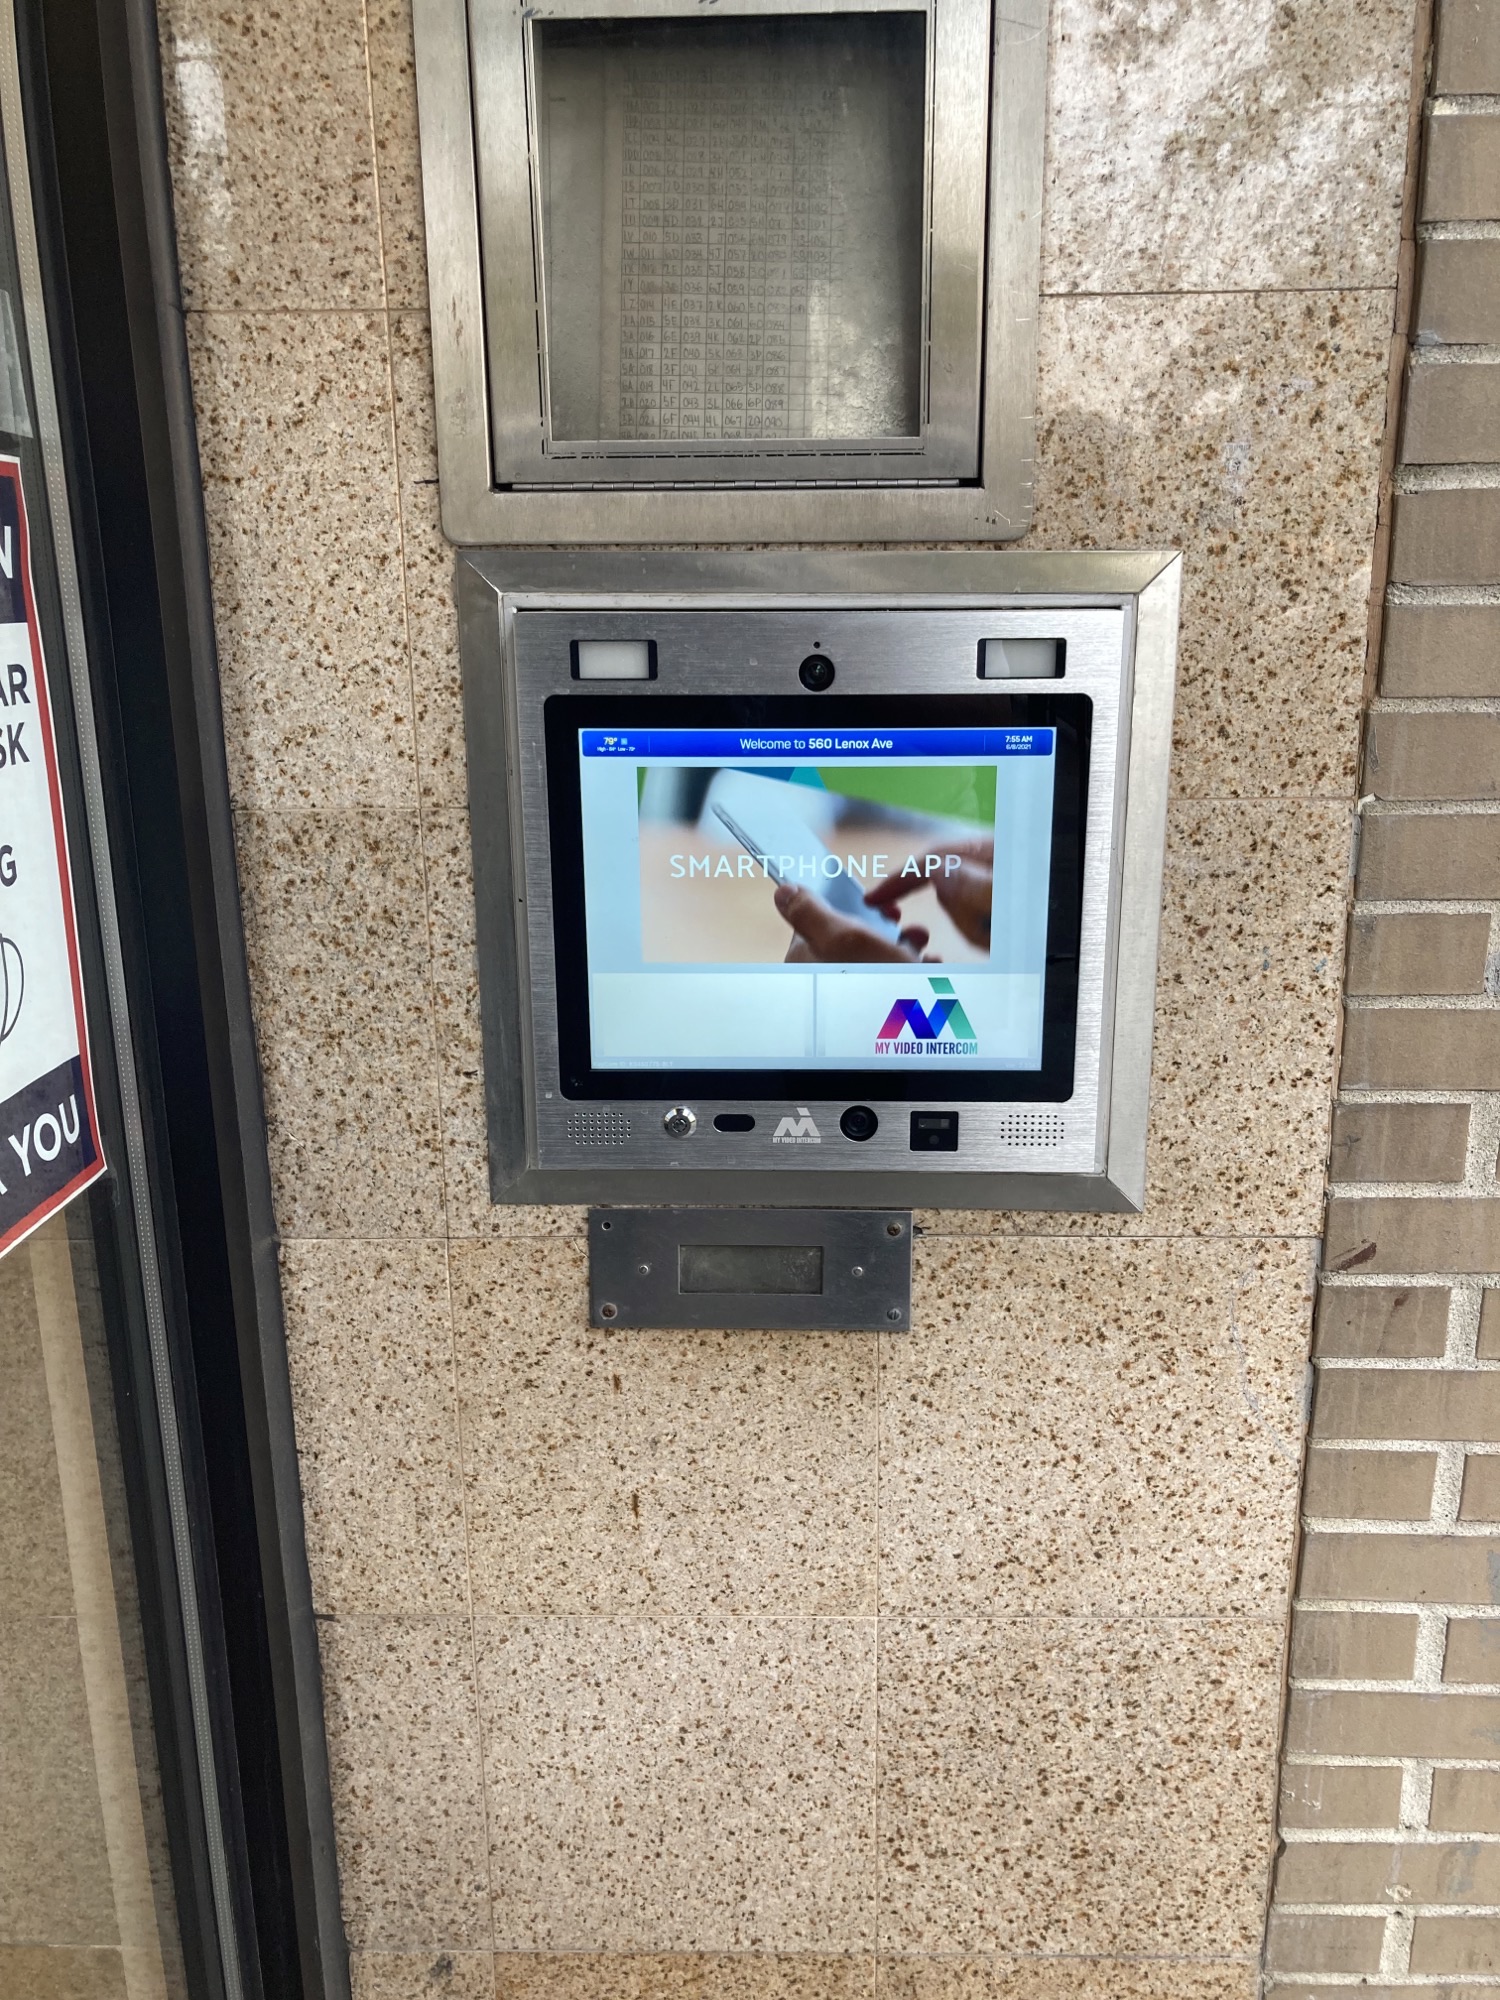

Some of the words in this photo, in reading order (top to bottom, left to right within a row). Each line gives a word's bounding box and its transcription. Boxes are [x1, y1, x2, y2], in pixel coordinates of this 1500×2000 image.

[625, 197, 637, 209] 1T
[643, 231, 657, 241] 010
[665, 232, 679, 242] 5D
[714, 233, 725, 243] J
[624, 249, 634, 257] 1W
[641, 247, 654, 258] 011
[728, 249, 745, 260] 057
[624, 279, 634, 291] 1Y
[684, 282, 702, 293] 036
[709, 283, 721, 293] 6J
[640, 299, 654, 310] 014
[664, 297, 677, 310] 4E
[684, 299, 702, 310] 037
[664, 315, 676, 326] 5E
[709, 318, 720, 327] 3K
[728, 318, 742, 327] 061
[664, 331, 677, 341] 6E
[683, 332, 700, 342] 039
[708, 333, 719, 342] 4K
[639, 348, 654, 357] 017
[664, 348, 677, 358] 2F
[683, 348, 700, 358] 040
[708, 349, 721, 358] 5K
[664, 364, 678, 374] 3F
[683, 364, 697, 375] 041
[663, 380, 676, 391] 4F
[683, 380, 700, 391] 042
[707, 382, 719, 392] 2L
[749, 382, 761, 392] 5P
[664, 396, 676, 408] 5F
[683, 397, 699, 408] 043
[707, 398, 719, 408] 3L
[726, 399, 743, 408] 066
[748, 398, 761, 407] 6P
[663, 413, 677, 424] 6F
[683, 415, 700, 425] 044
[707, 415, 718, 426] 4L
[725, 416, 741, 425] 067
[740, 738, 792, 750] Welcome
[794, 739, 806, 750] to
[808, 738, 832, 749] 560
[835, 738, 869, 749] Lenox
[871, 738, 893, 749] Ave
[1005, 735, 1021, 743] 7:55
[1021, 735, 1033, 743] AM
[669, 854, 889, 879] SMARTPHONE
[900, 854, 962, 878] APP
[875, 1042, 890, 1055] MY
[893, 1042, 923, 1055] VIDEO
[926, 1042, 978, 1055] INTERCOM
[7, 1094, 80, 1177] YOU
